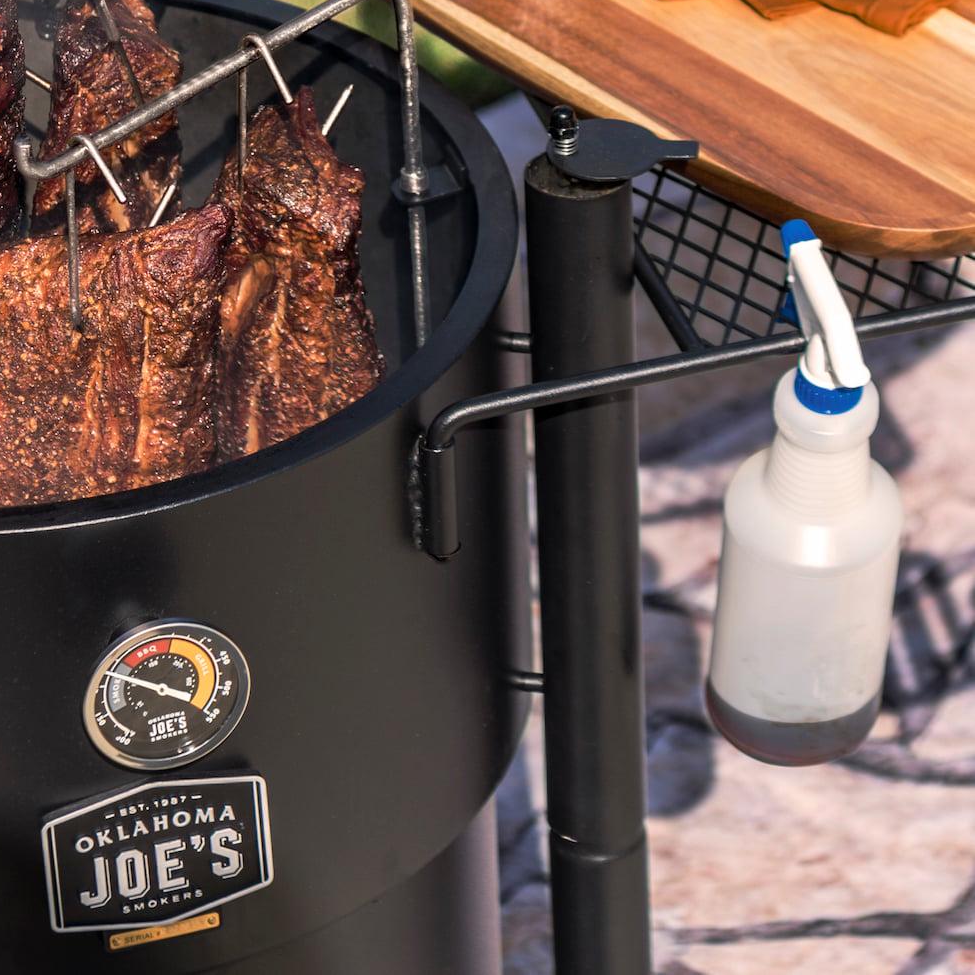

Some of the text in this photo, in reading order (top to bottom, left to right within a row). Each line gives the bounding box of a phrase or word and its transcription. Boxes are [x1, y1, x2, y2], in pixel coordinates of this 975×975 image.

[136, 645, 158, 658] BBQ
[112, 675, 122, 704] SMOK
[149, 716, 187, 737] JOE'S
[119, 794, 188, 818] EST. 1987
[74, 805, 237, 854] OKLAHOMA
[79, 827, 244, 910] JOE'S
[122, 888, 204, 915] SMOKERS
[124, 931, 155, 944] SERIAL
